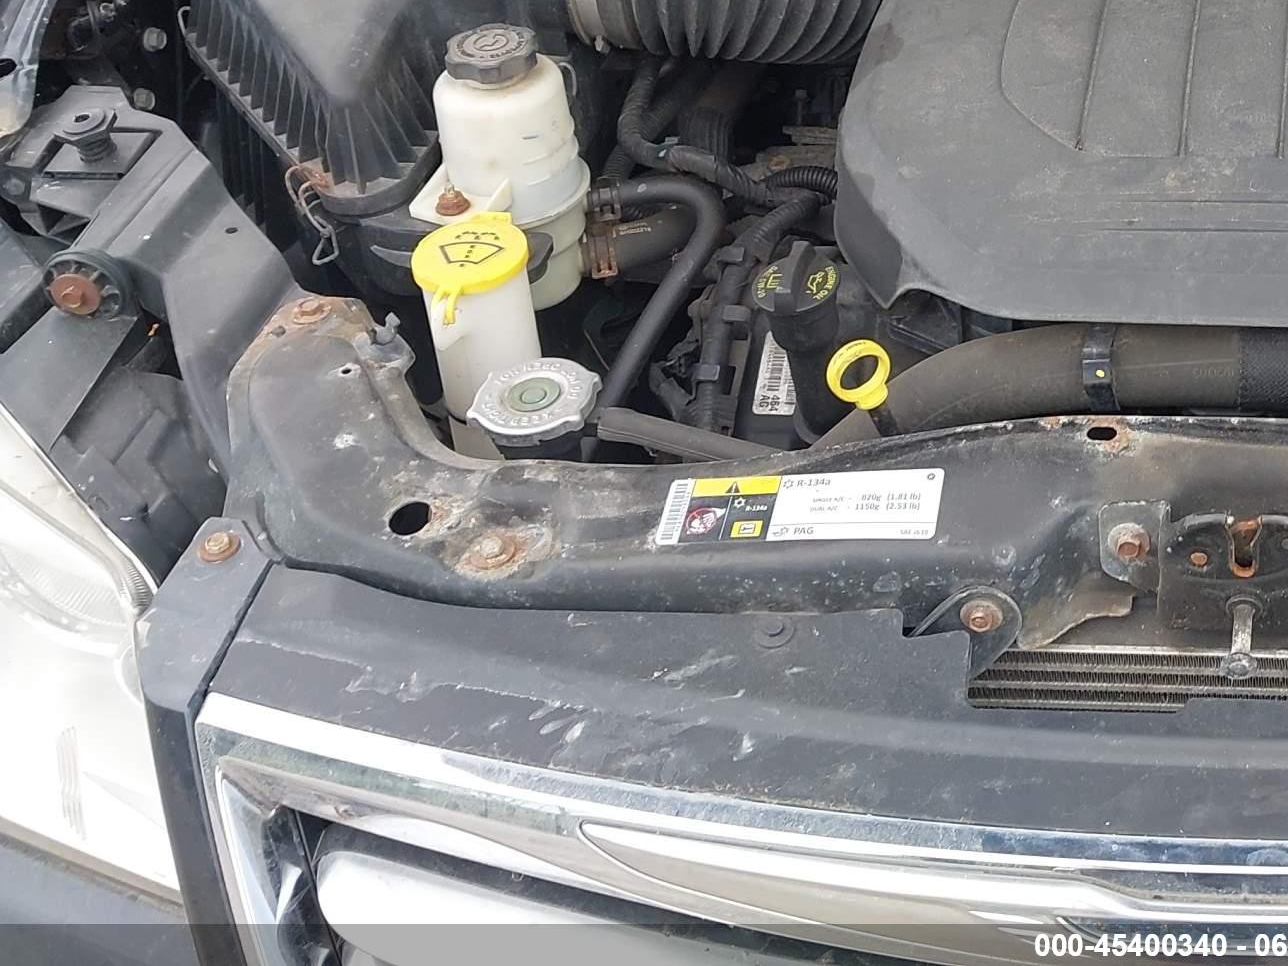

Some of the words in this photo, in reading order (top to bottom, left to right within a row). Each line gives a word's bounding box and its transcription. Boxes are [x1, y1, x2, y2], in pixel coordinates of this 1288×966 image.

[824, 266, 836, 290] ENGINE
[812, 290, 828, 300] OIL
[760, 394, 770, 409] AG
[768, 395, 781, 412] 464
[797, 478, 832, 487] R-134a
